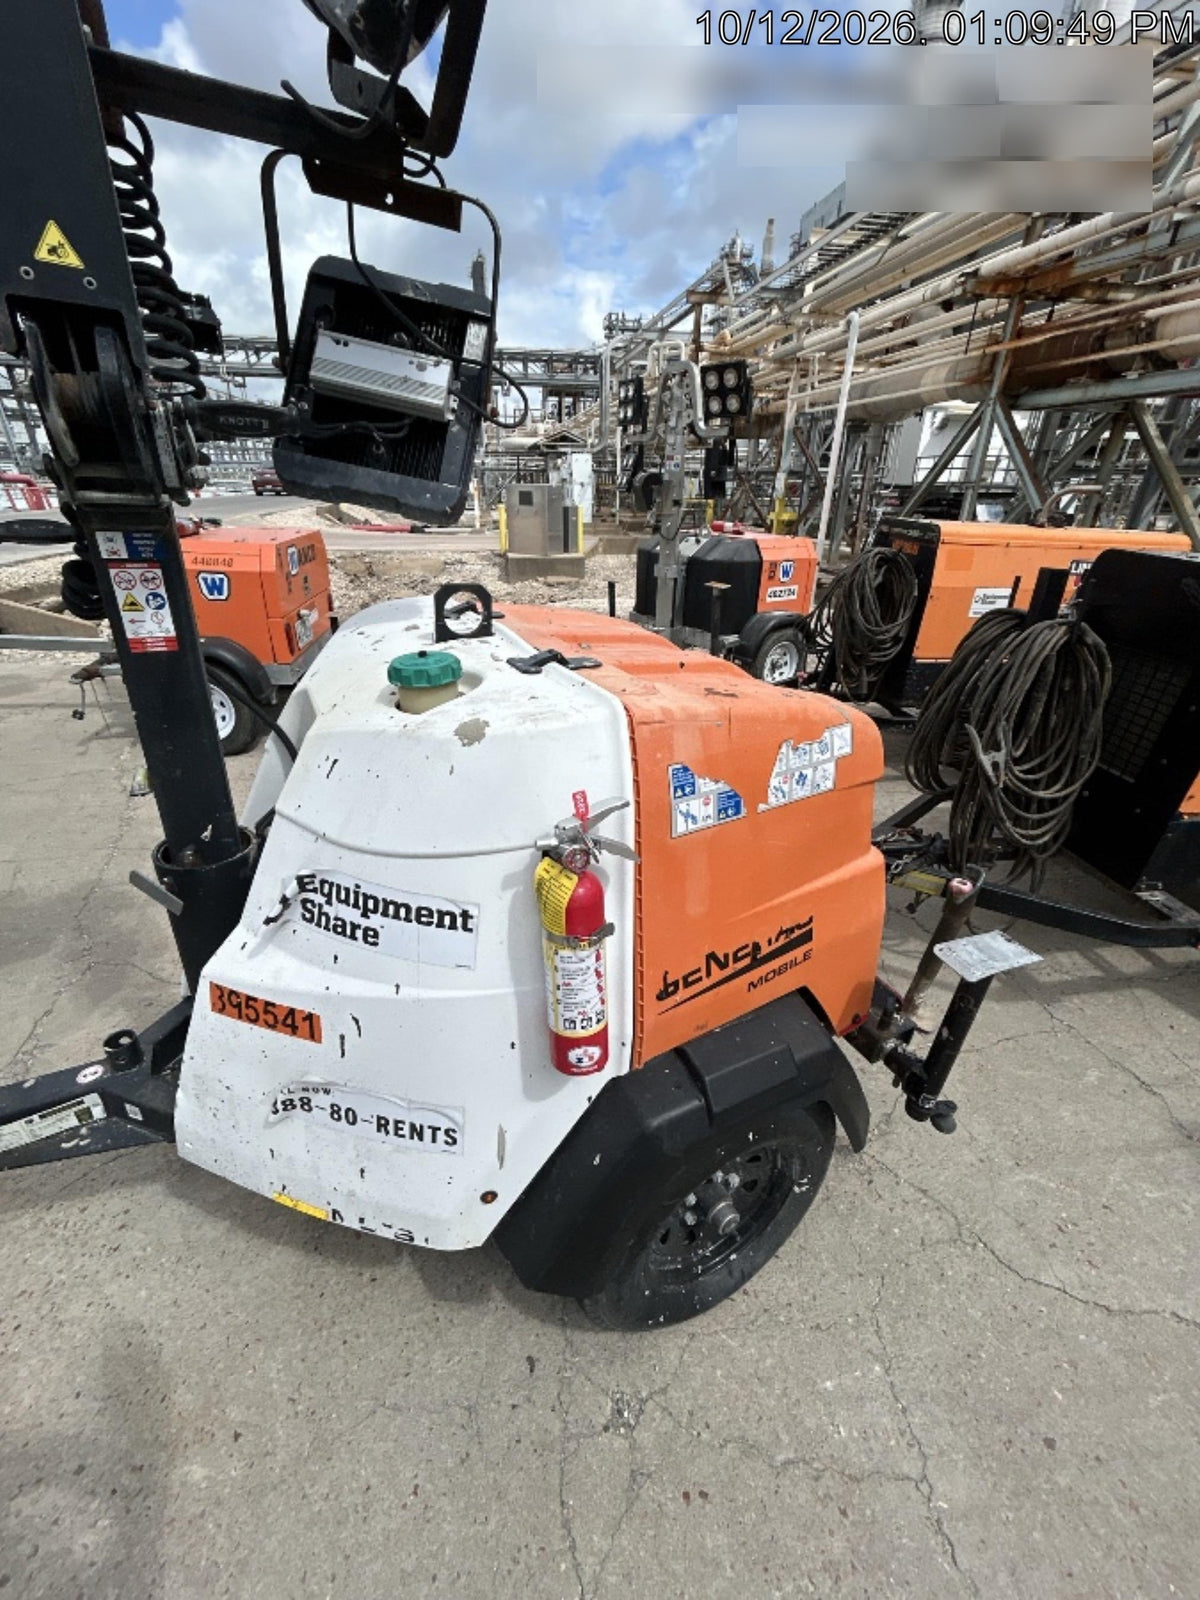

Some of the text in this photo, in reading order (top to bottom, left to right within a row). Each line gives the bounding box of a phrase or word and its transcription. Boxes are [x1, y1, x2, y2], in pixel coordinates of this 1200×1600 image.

[200, 576, 225, 596] W
[296, 873, 474, 933] Equipment
[300, 897, 380, 947] Share
[747, 949, 813, 992] MOBILE
[214, 984, 317, 1042] 395541
